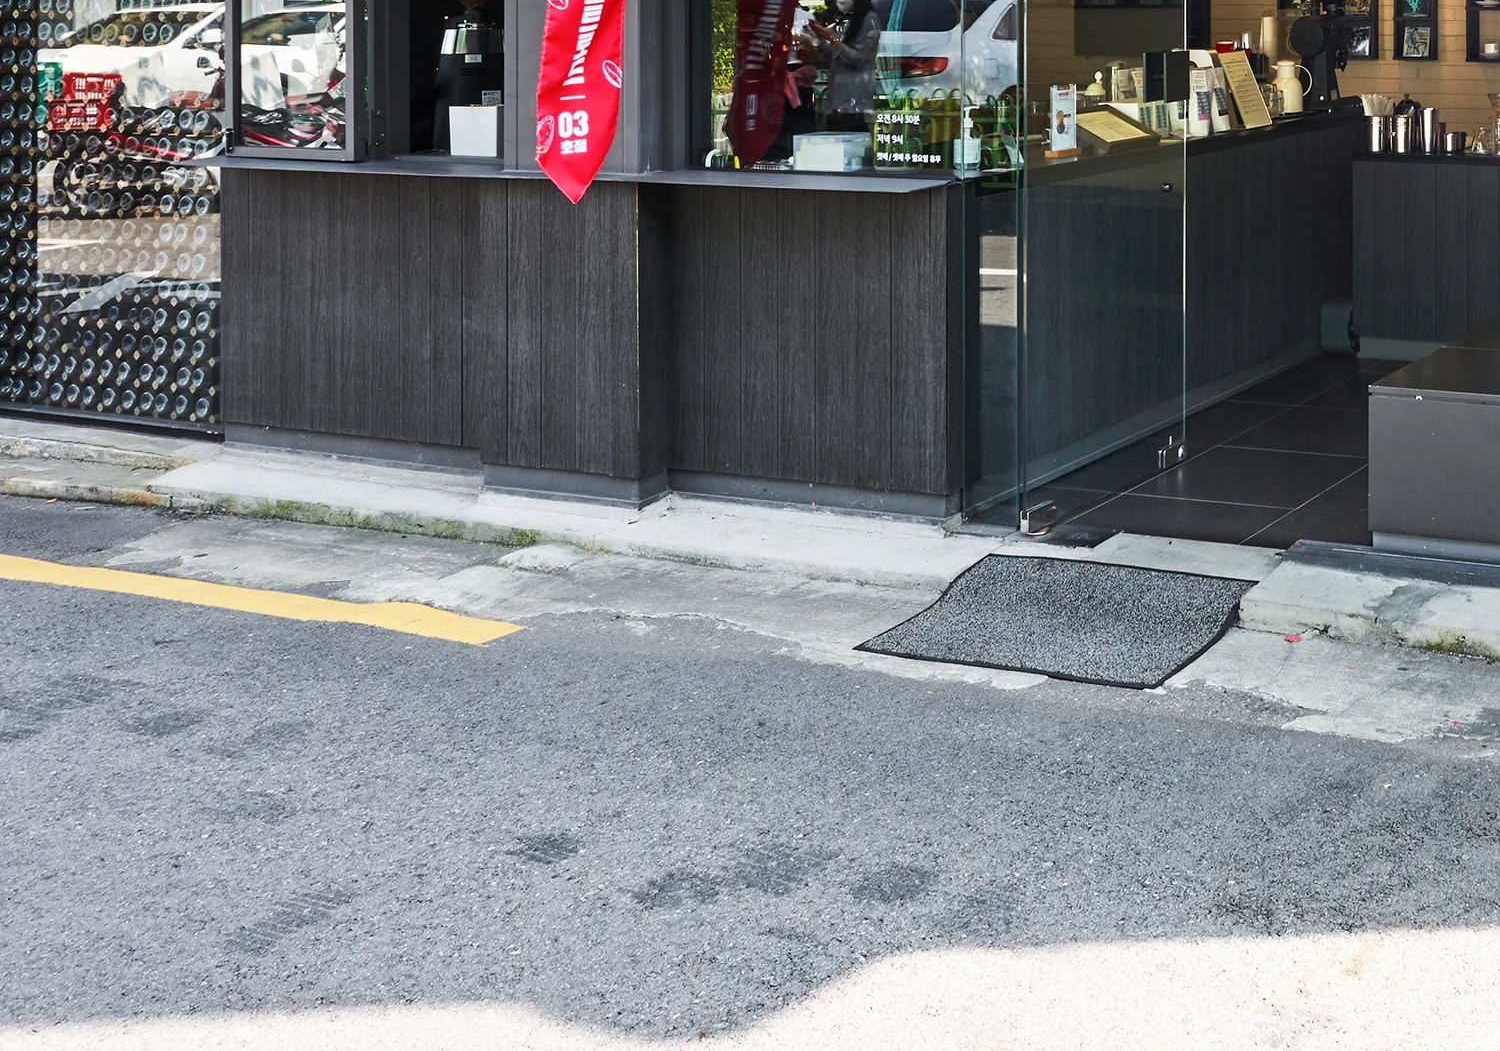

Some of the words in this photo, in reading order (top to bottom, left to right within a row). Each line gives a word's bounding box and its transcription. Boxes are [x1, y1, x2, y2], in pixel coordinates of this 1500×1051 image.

[558, 110, 589, 138] 03
[876, 113, 891, 124] 오전
[891, 114, 904, 124] 8시
[904, 114, 921, 125] 30분
[876, 133, 891, 144] 저녁
[891, 134, 904, 145] 9시
[560, 138, 587, 155] 호점
